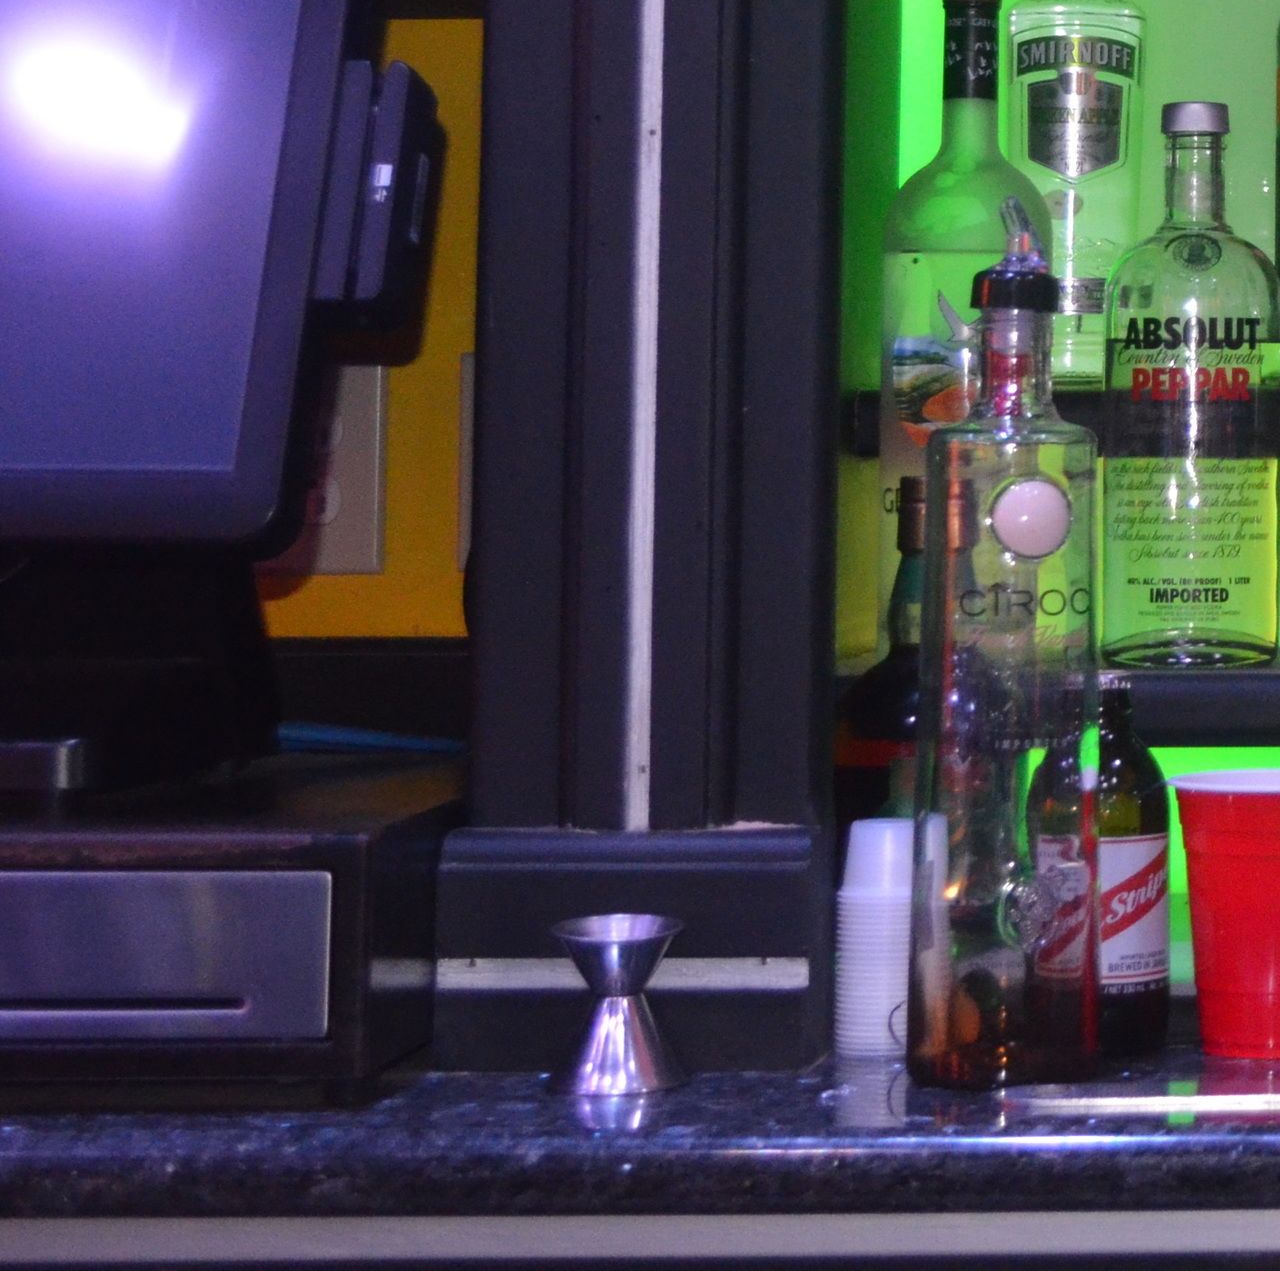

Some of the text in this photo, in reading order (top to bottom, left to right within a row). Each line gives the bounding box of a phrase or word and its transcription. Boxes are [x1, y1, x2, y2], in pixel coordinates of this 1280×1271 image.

[1020, 40, 1133, 70] SMIRNOFF
[1124, 316, 1261, 350] ABSOLUT
[1205, 345, 1266, 368] Sweden
[1131, 367, 1251, 403] PEPPAR
[1149, 587, 1230, 604] IMPORTED
[1108, 960, 1143, 974] BREWED
